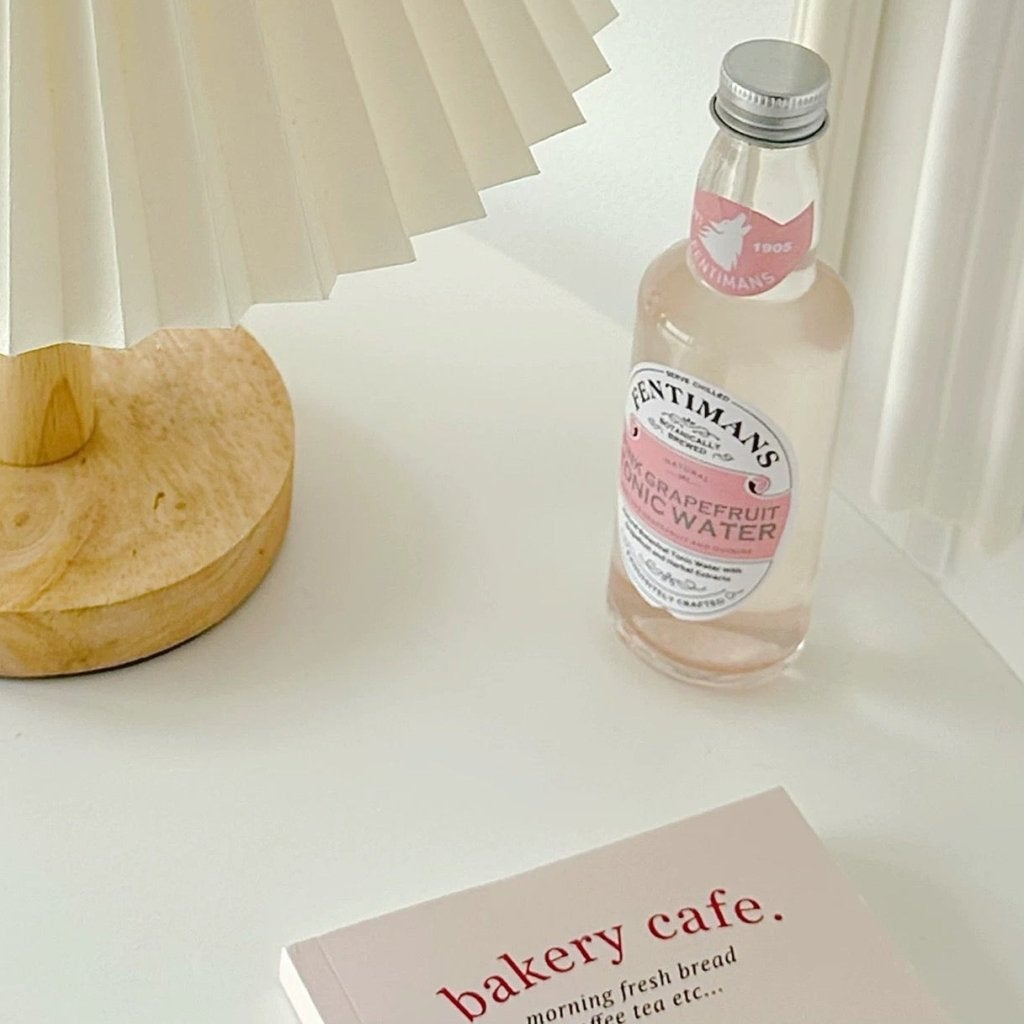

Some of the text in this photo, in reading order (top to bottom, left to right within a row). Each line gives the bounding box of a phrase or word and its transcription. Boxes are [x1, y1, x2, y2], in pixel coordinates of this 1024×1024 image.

[753, 241, 794, 254] 1905
[631, 378, 780, 468] FENTIMANS
[622, 460, 667, 515] ONIC
[671, 505, 778, 543] WATER
[645, 469, 781, 522] GRAPEFRUIT
[435, 888, 783, 1023] bakery cafe.
[526, 945, 738, 1024] morning fresh bread
[580, 985, 724, 1024] ffee tea etc...
